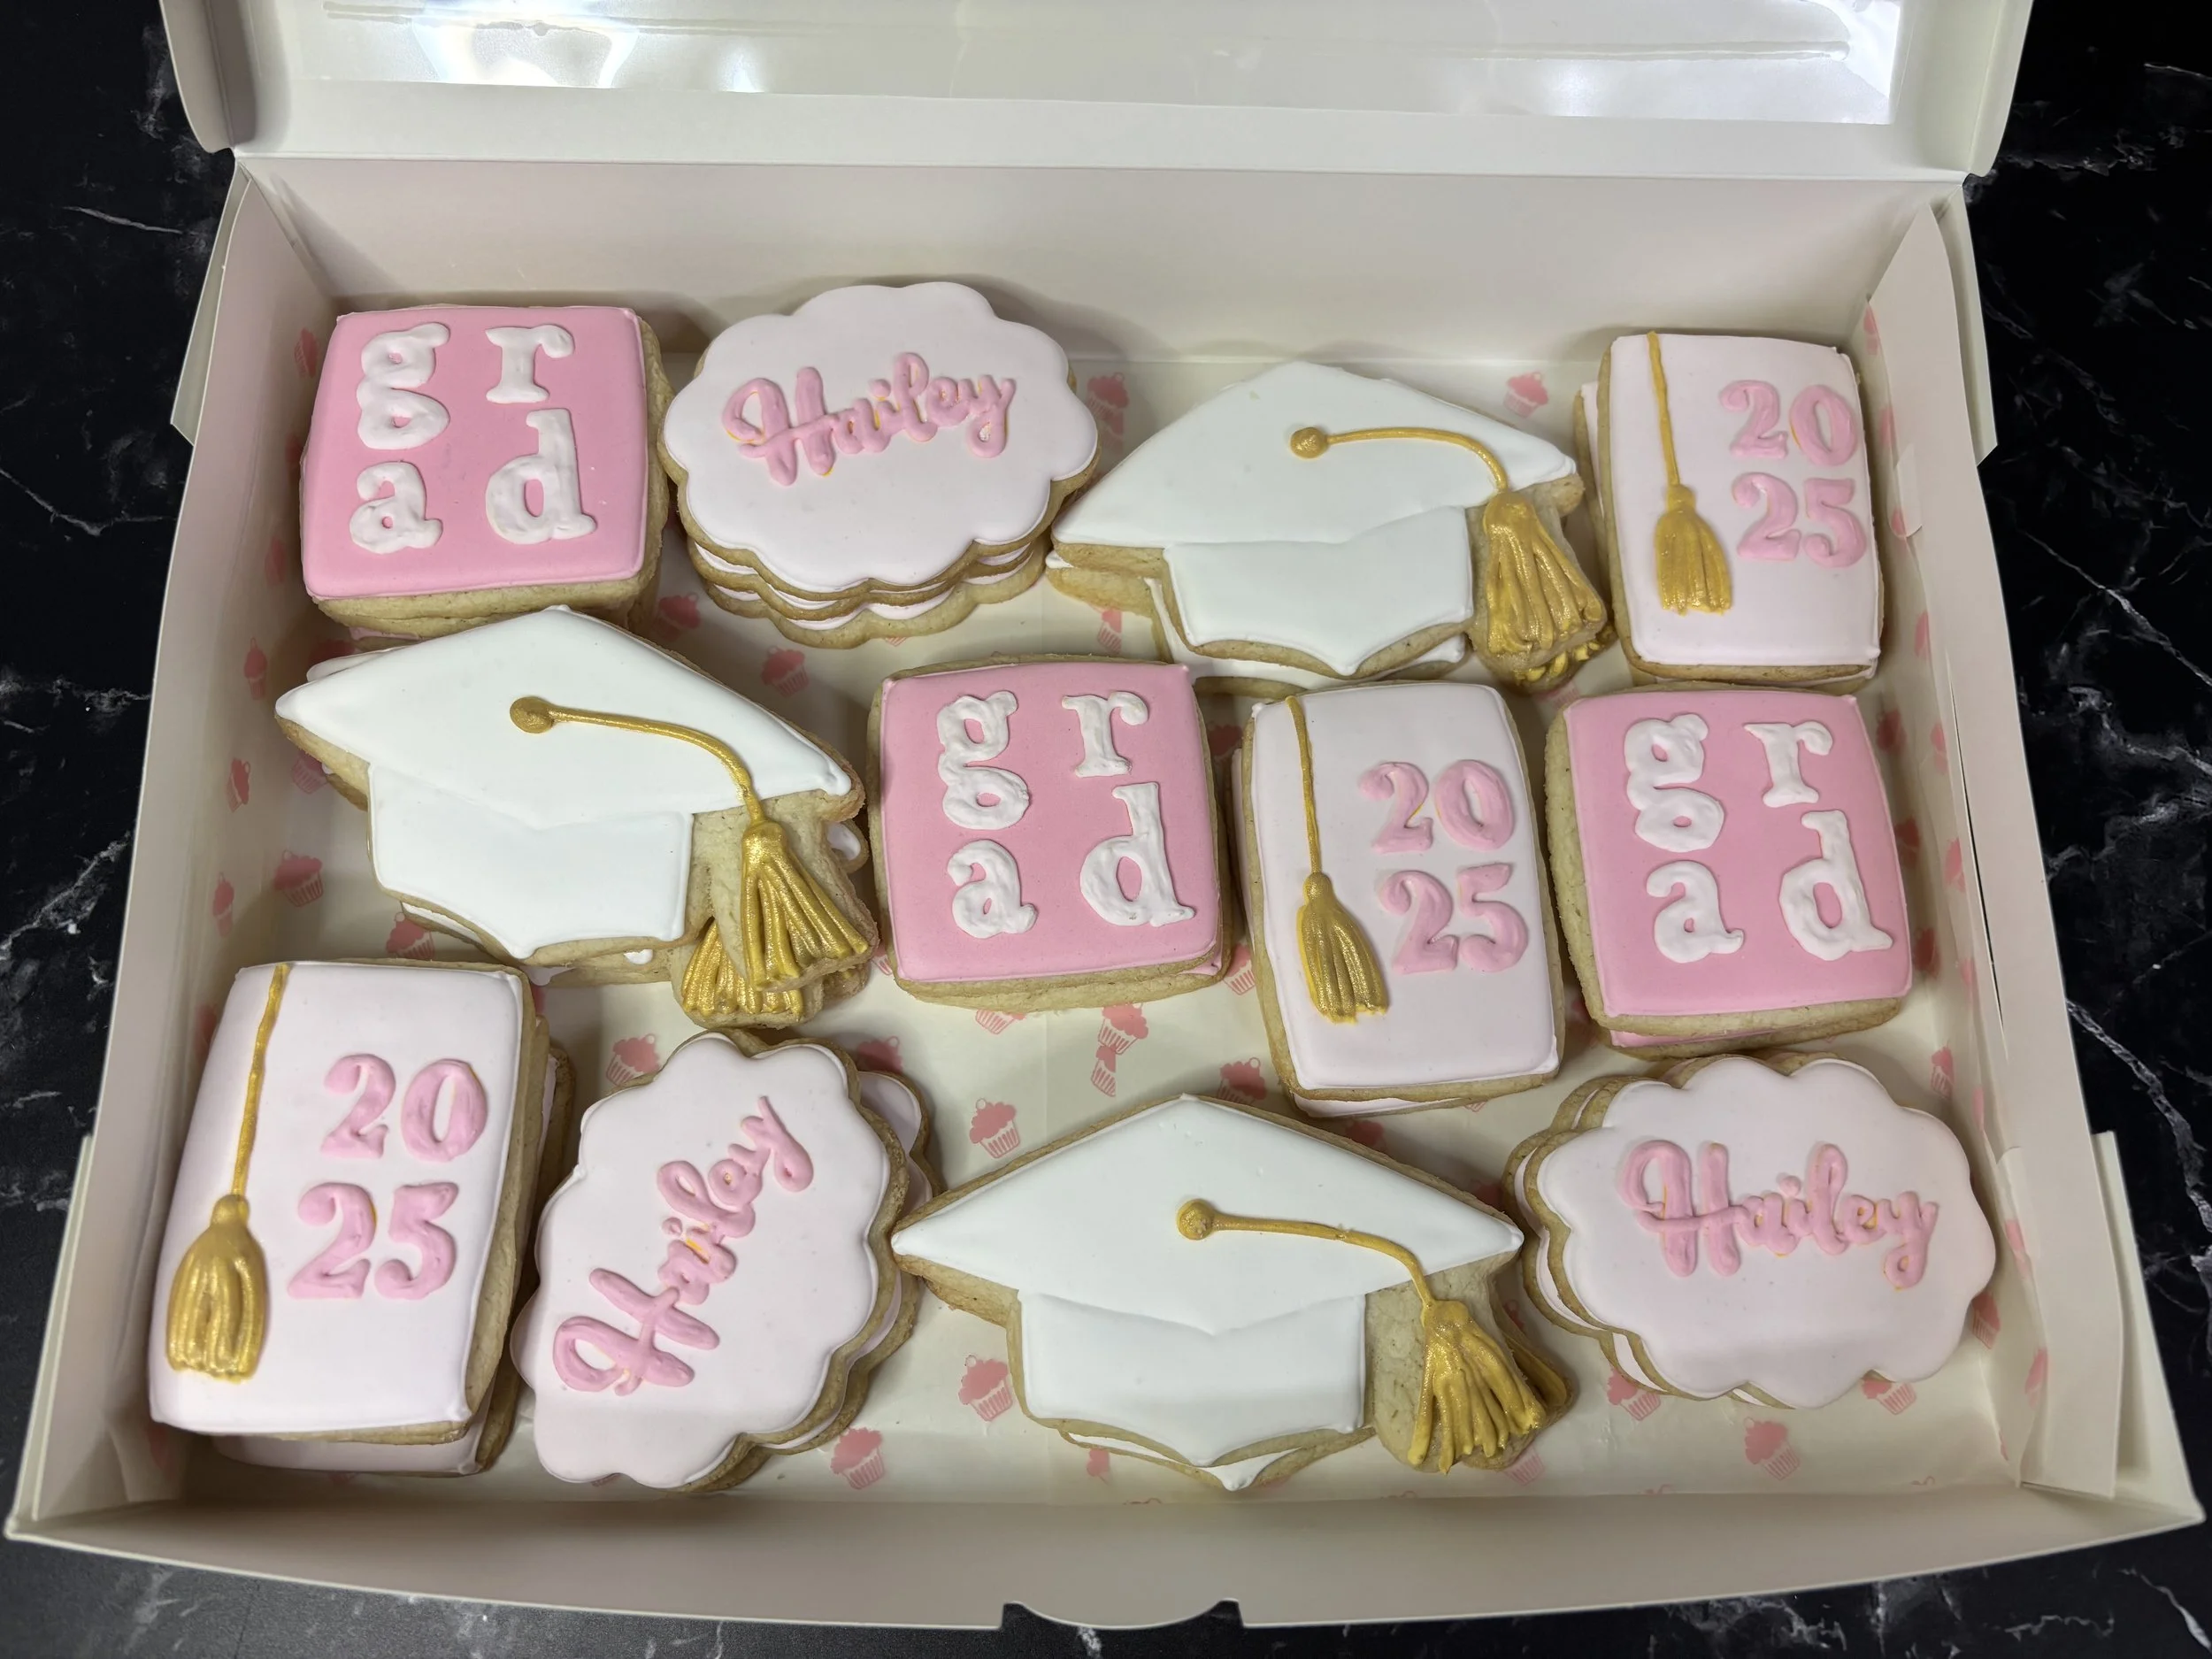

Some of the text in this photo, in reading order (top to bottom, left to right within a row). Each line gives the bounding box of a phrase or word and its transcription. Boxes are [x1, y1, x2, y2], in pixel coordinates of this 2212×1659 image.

[721, 351, 1017, 487] Hailey
[1718, 379, 1857, 467] 20
[1732, 471, 1868, 569] 25
[1359, 759, 1515, 854] 20
[1379, 862, 1529, 973] 25
[321, 1053, 488, 1164] 20
[287, 1182, 458, 1301] 25
[553, 1095, 814, 1396] Hailey
[1619, 1139, 1939, 1290] Hailey
